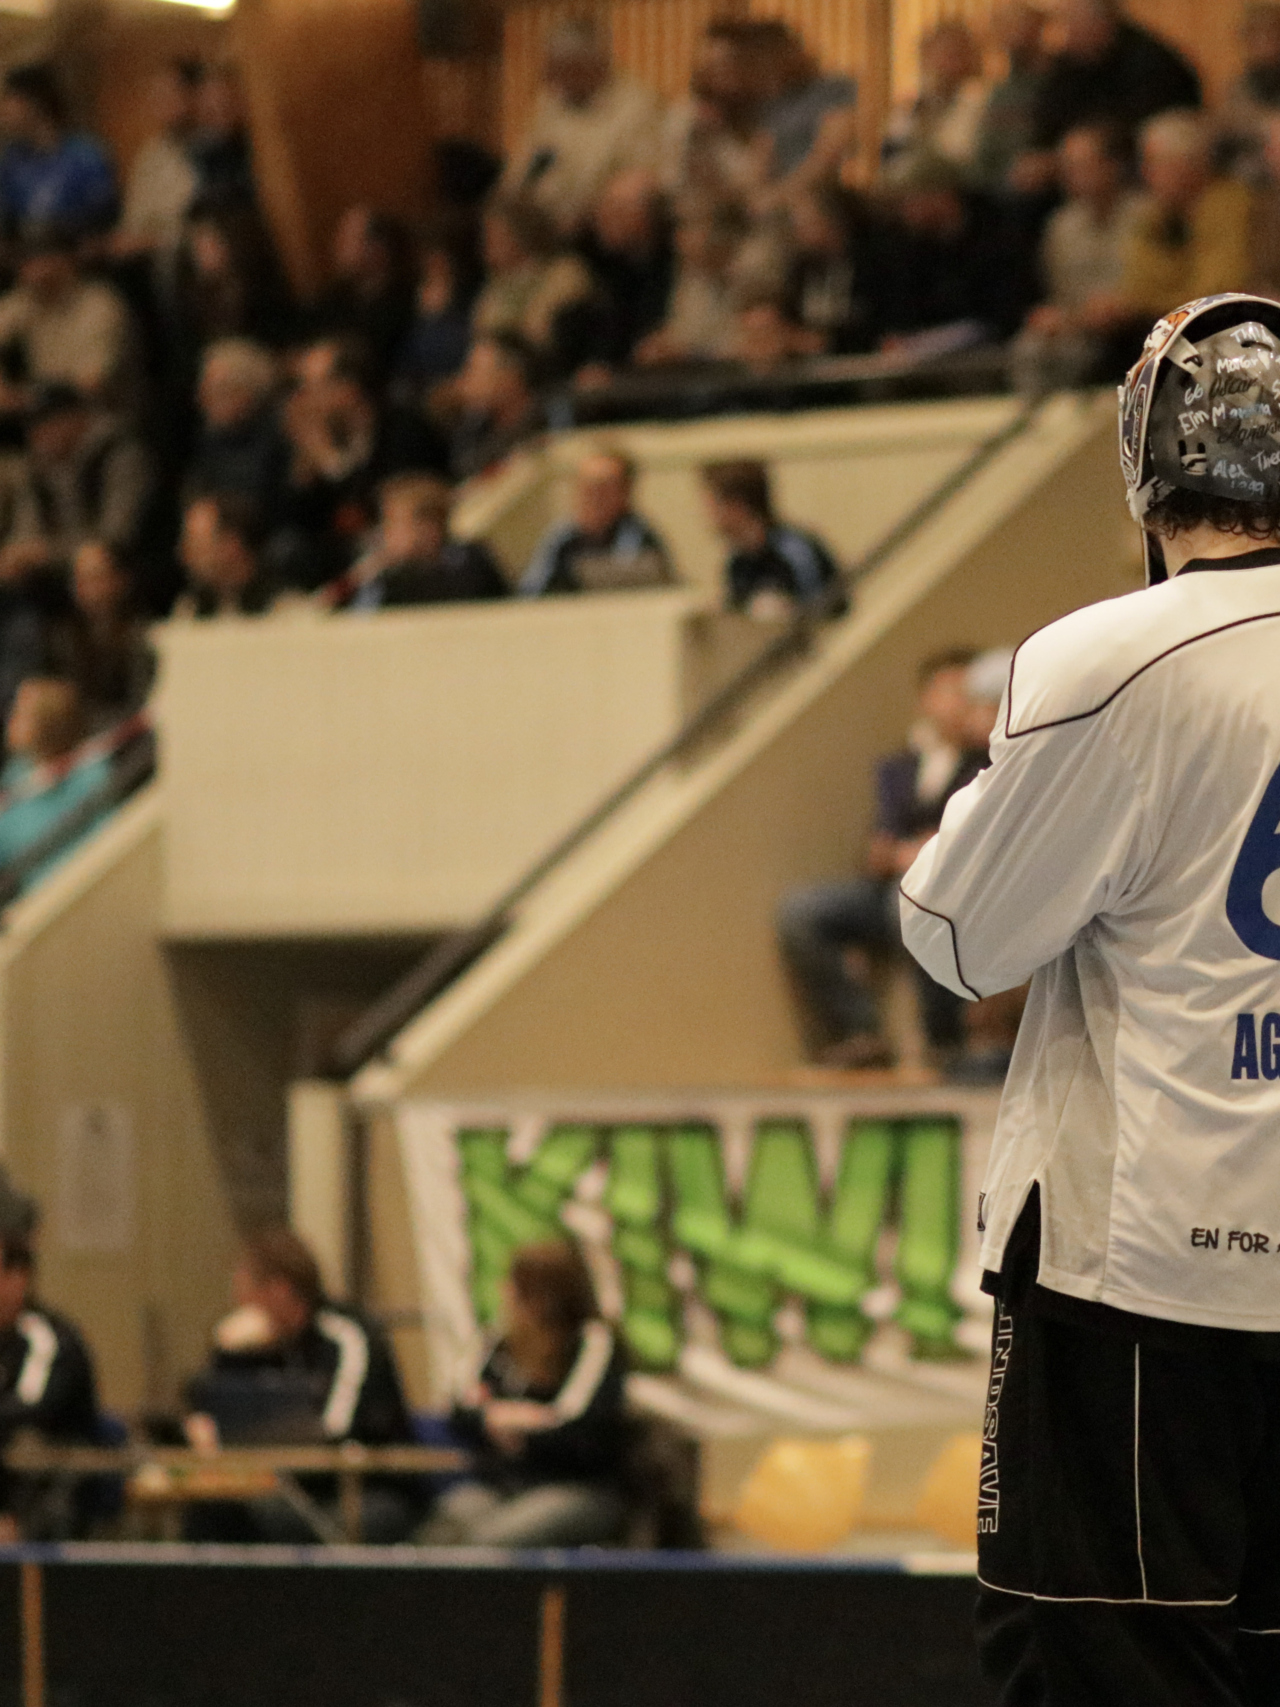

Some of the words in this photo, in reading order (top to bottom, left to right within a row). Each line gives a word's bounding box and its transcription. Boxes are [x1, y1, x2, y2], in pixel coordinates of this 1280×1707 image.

[1184, 384, 1204, 406] 66
[1212, 459, 1250, 479] Alex
[1191, 1227, 1220, 1250] EN
[1228, 1230, 1270, 1254] FOR
